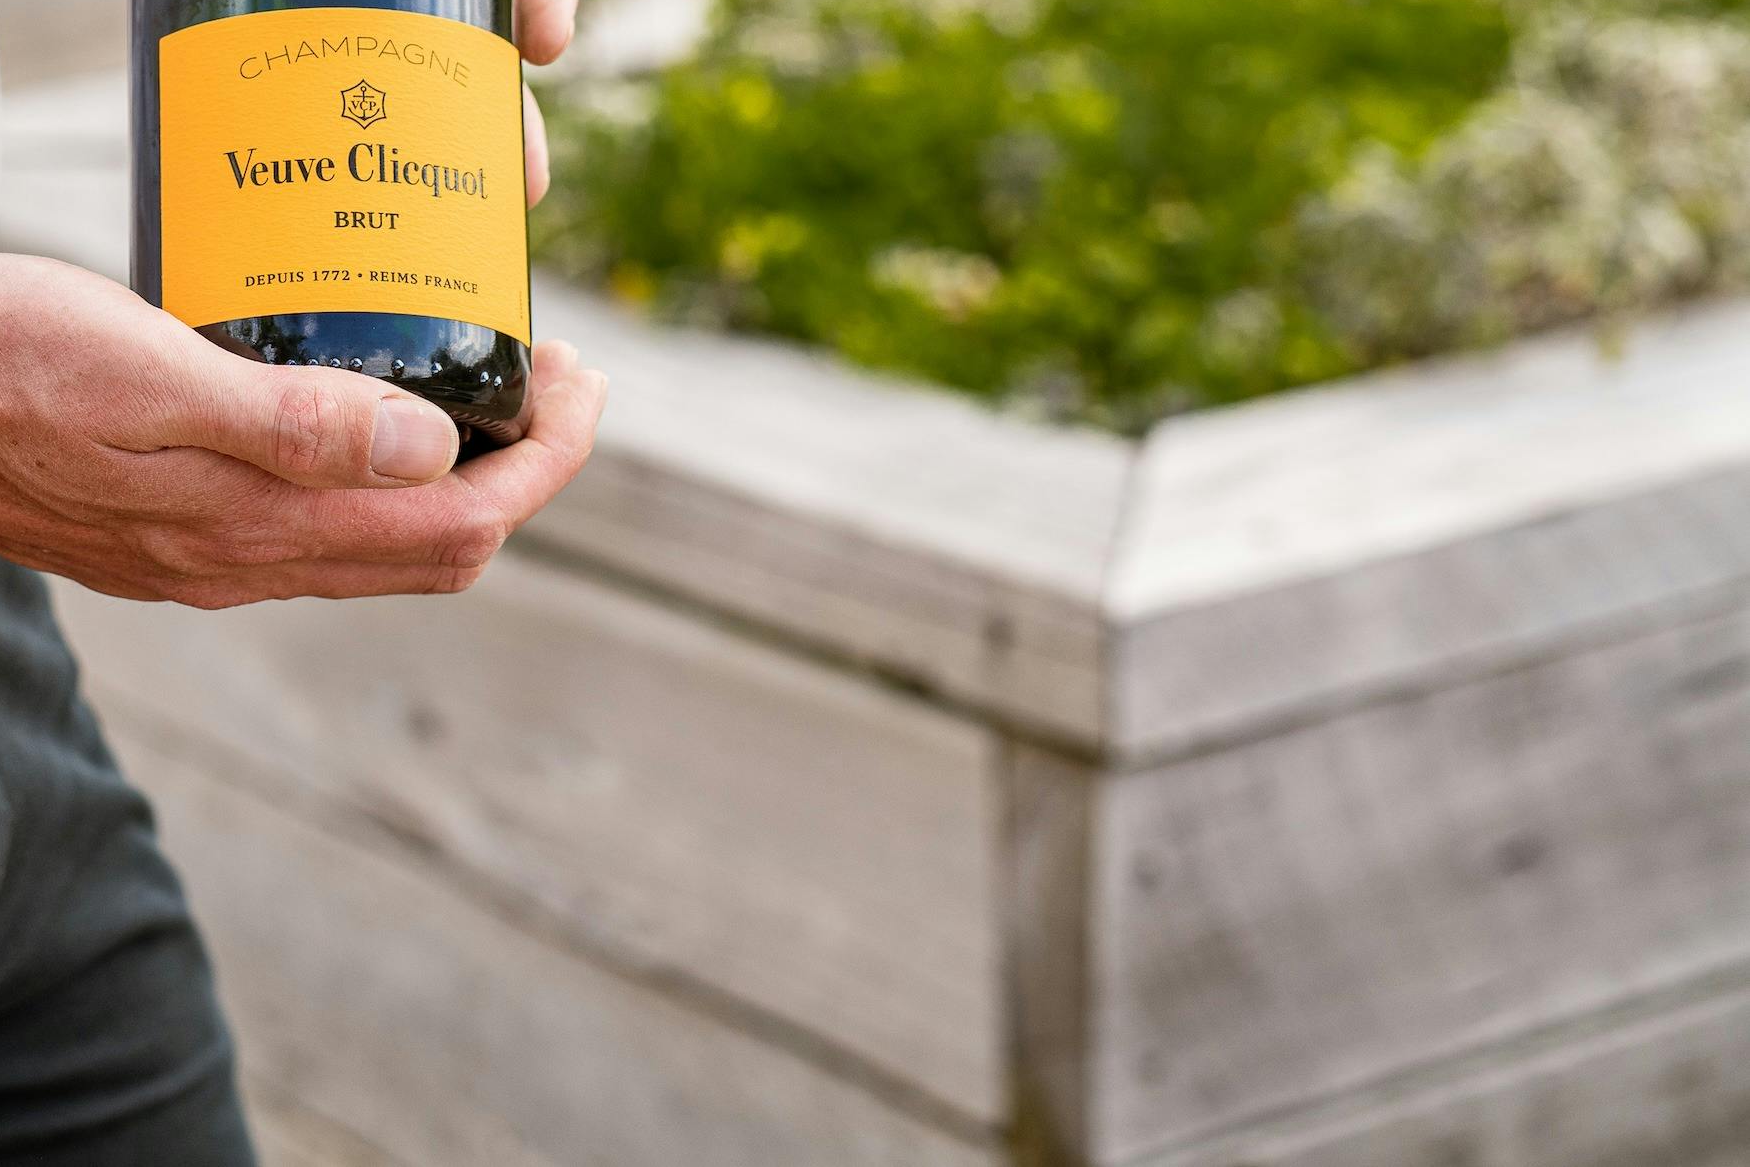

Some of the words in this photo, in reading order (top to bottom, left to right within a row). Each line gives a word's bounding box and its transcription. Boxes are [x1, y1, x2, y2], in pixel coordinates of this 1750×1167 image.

[238, 35, 471, 89] CHAMPAGNE
[351, 100, 377, 111] VCP
[224, 147, 336, 189] Veuve
[348, 142, 488, 200] Clicquot
[333, 210, 400, 231] BRUT
[245, 270, 304, 288] DEPUIS
[312, 269, 351, 282] 1772
[369, 270, 418, 285] REIMS
[425, 275, 479, 295] FRANCE
